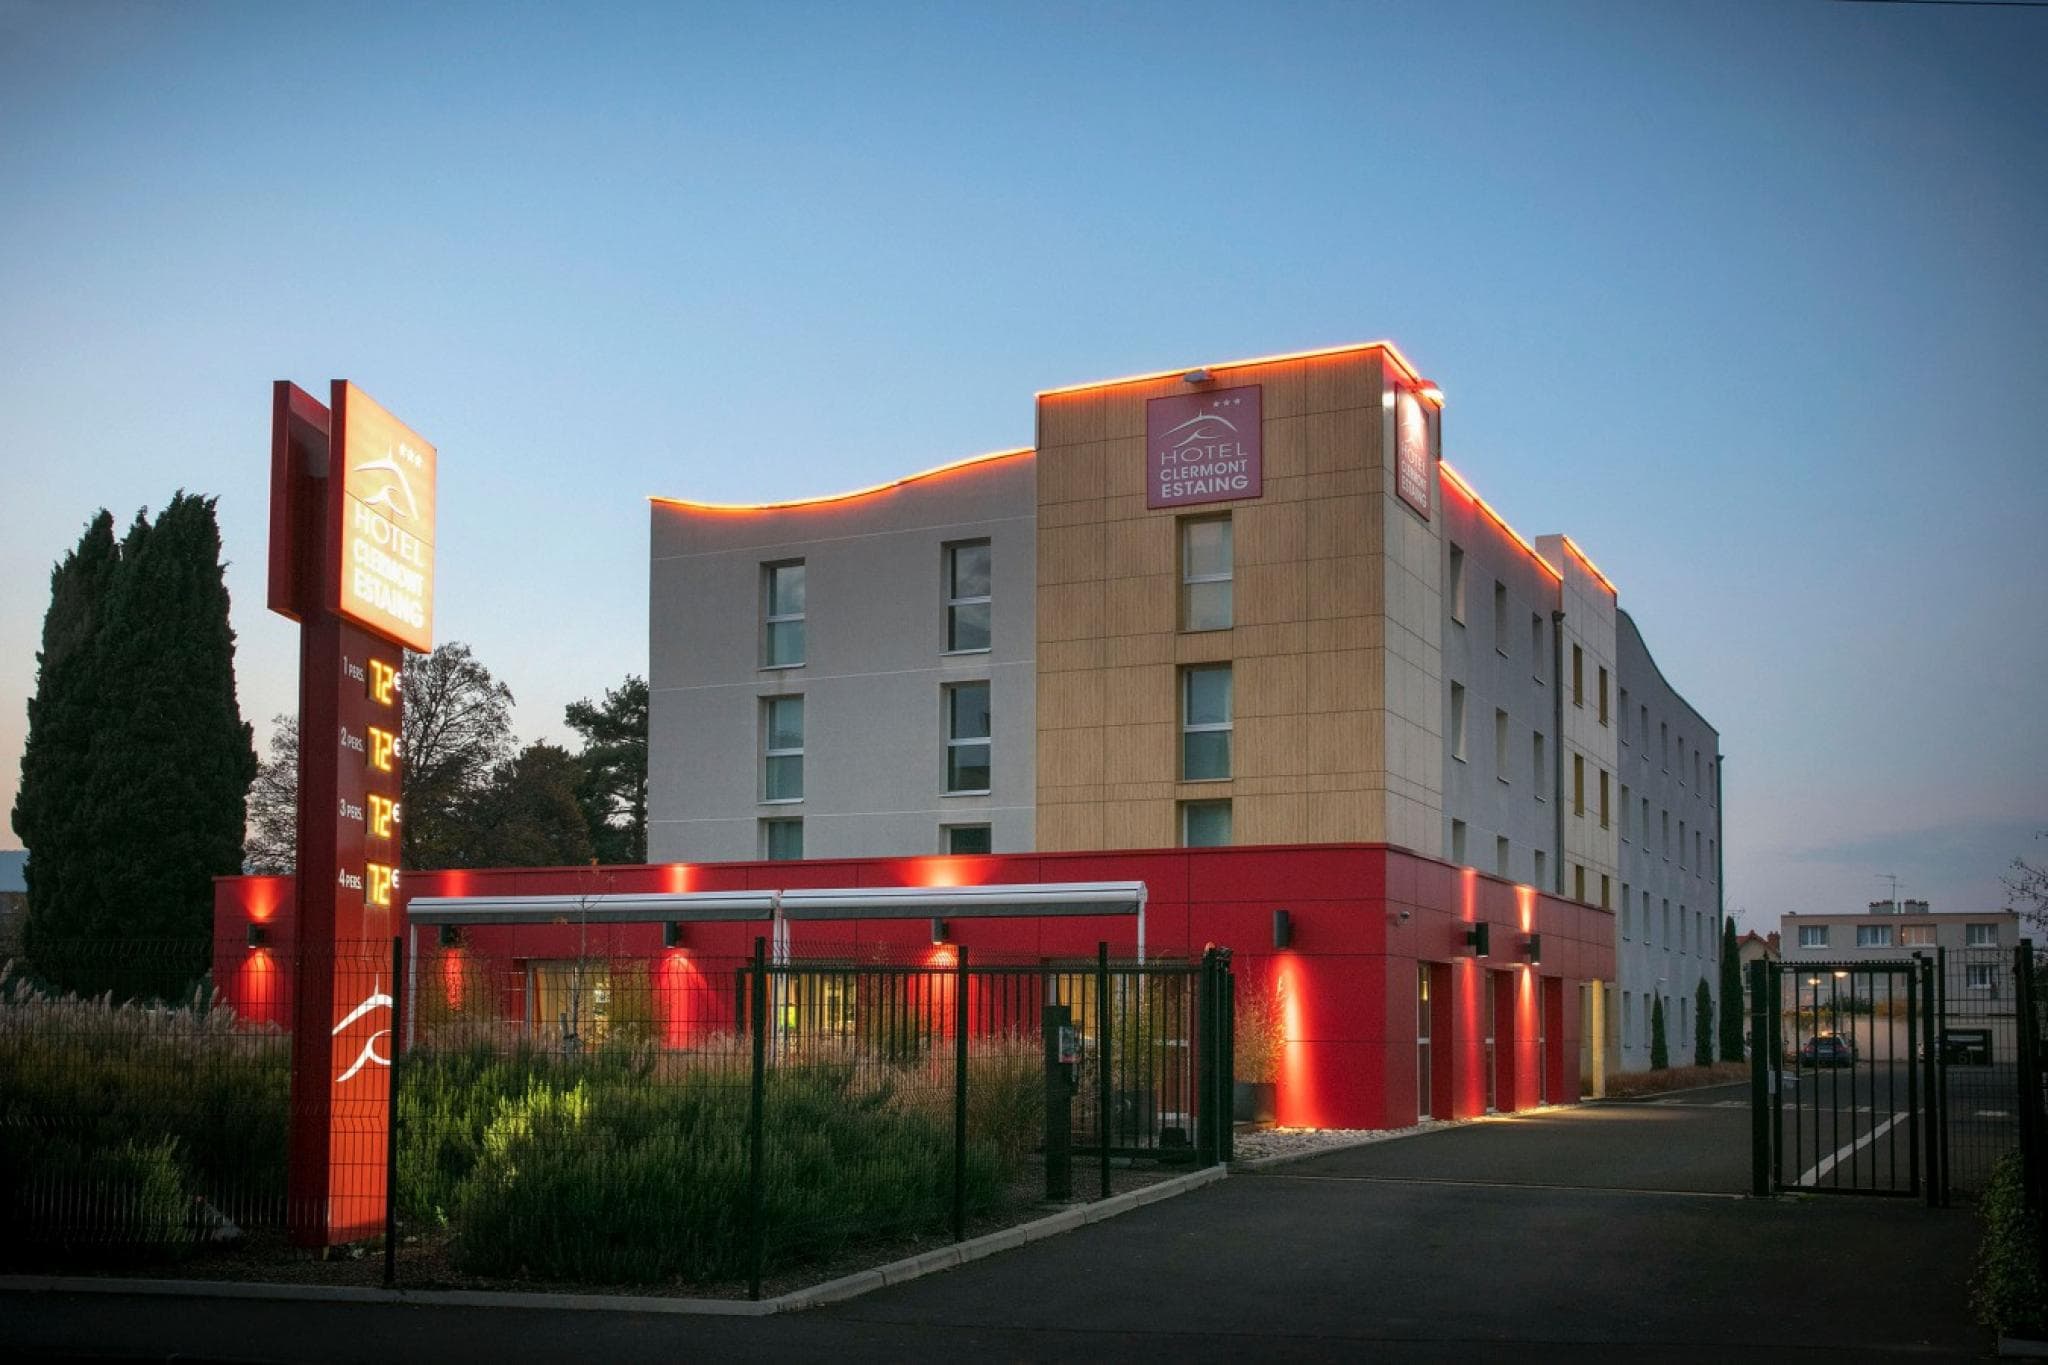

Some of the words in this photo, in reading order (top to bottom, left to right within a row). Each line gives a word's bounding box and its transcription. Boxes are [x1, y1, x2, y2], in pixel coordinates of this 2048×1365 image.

[1160, 441, 1248, 465] HOTEL
[1160, 459, 1248, 481] CLERMONT
[1161, 475, 1249, 498] ESTAING
[354, 501, 425, 568] HOTEL
[353, 538, 425, 597] CLERMONT
[353, 567, 425, 629] ESTAING
[340, 727, 347, 746] 2
[339, 798, 346, 817] 3
[338, 868, 345, 887] 4
